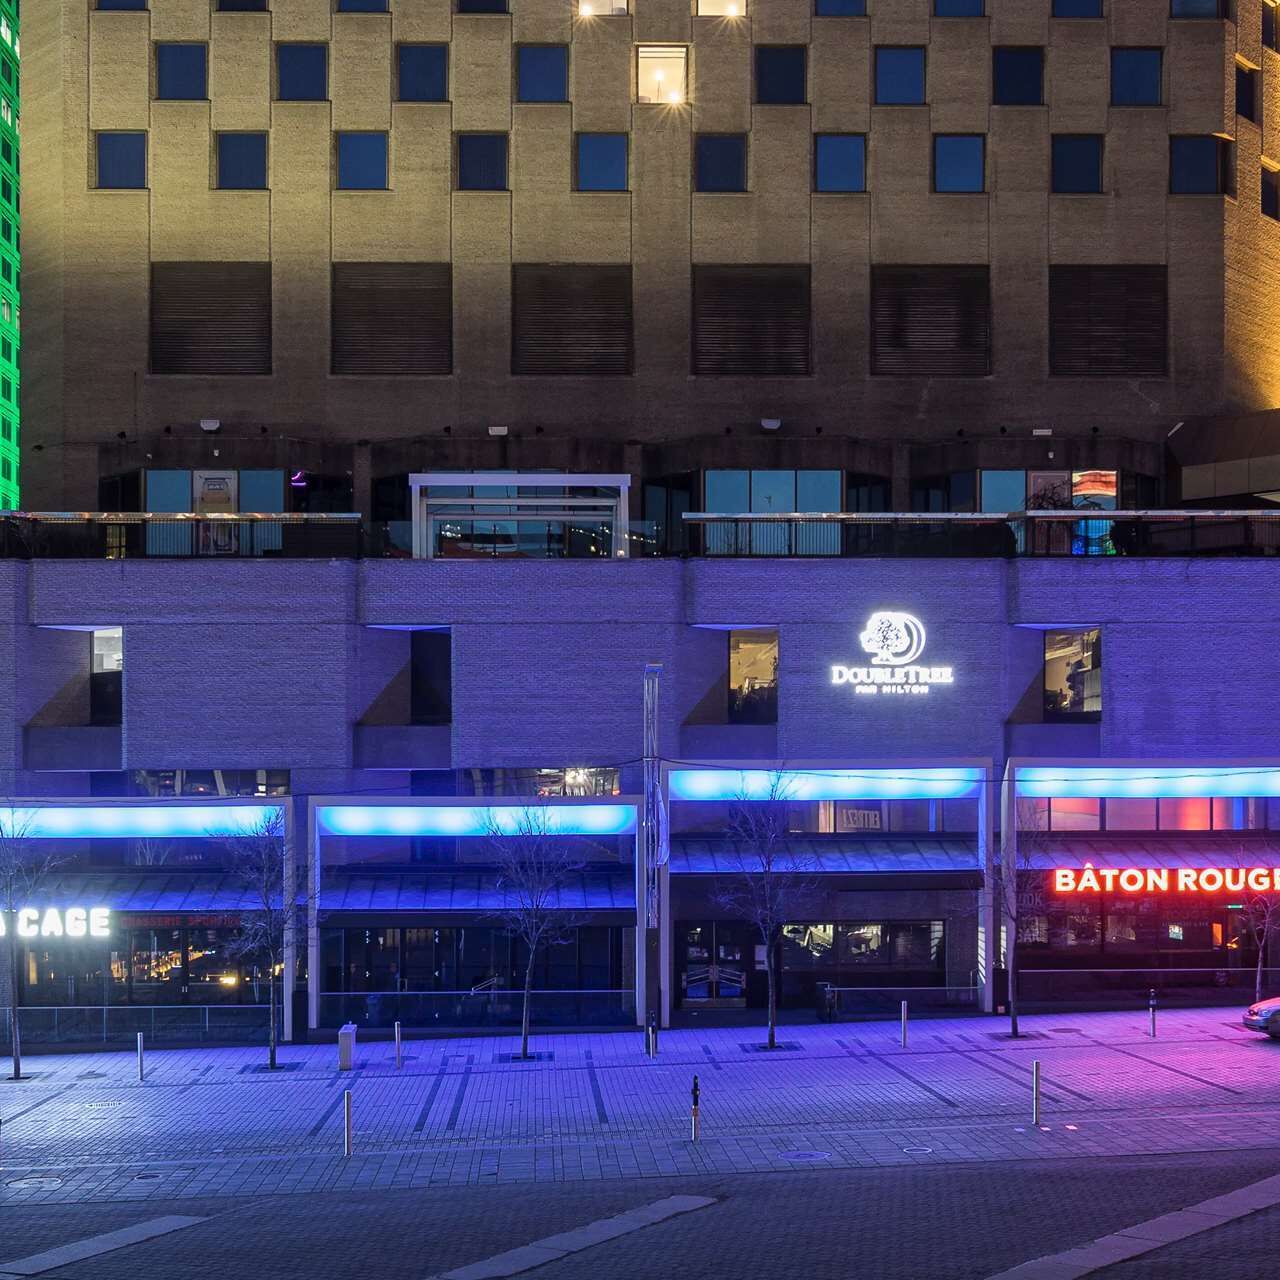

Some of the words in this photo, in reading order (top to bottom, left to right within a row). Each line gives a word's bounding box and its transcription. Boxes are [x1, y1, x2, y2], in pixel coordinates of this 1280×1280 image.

[882, 684, 929, 694] HILTON
[1055, 863, 1168, 891] BÂTON
[16, 907, 111, 938] CAGE
